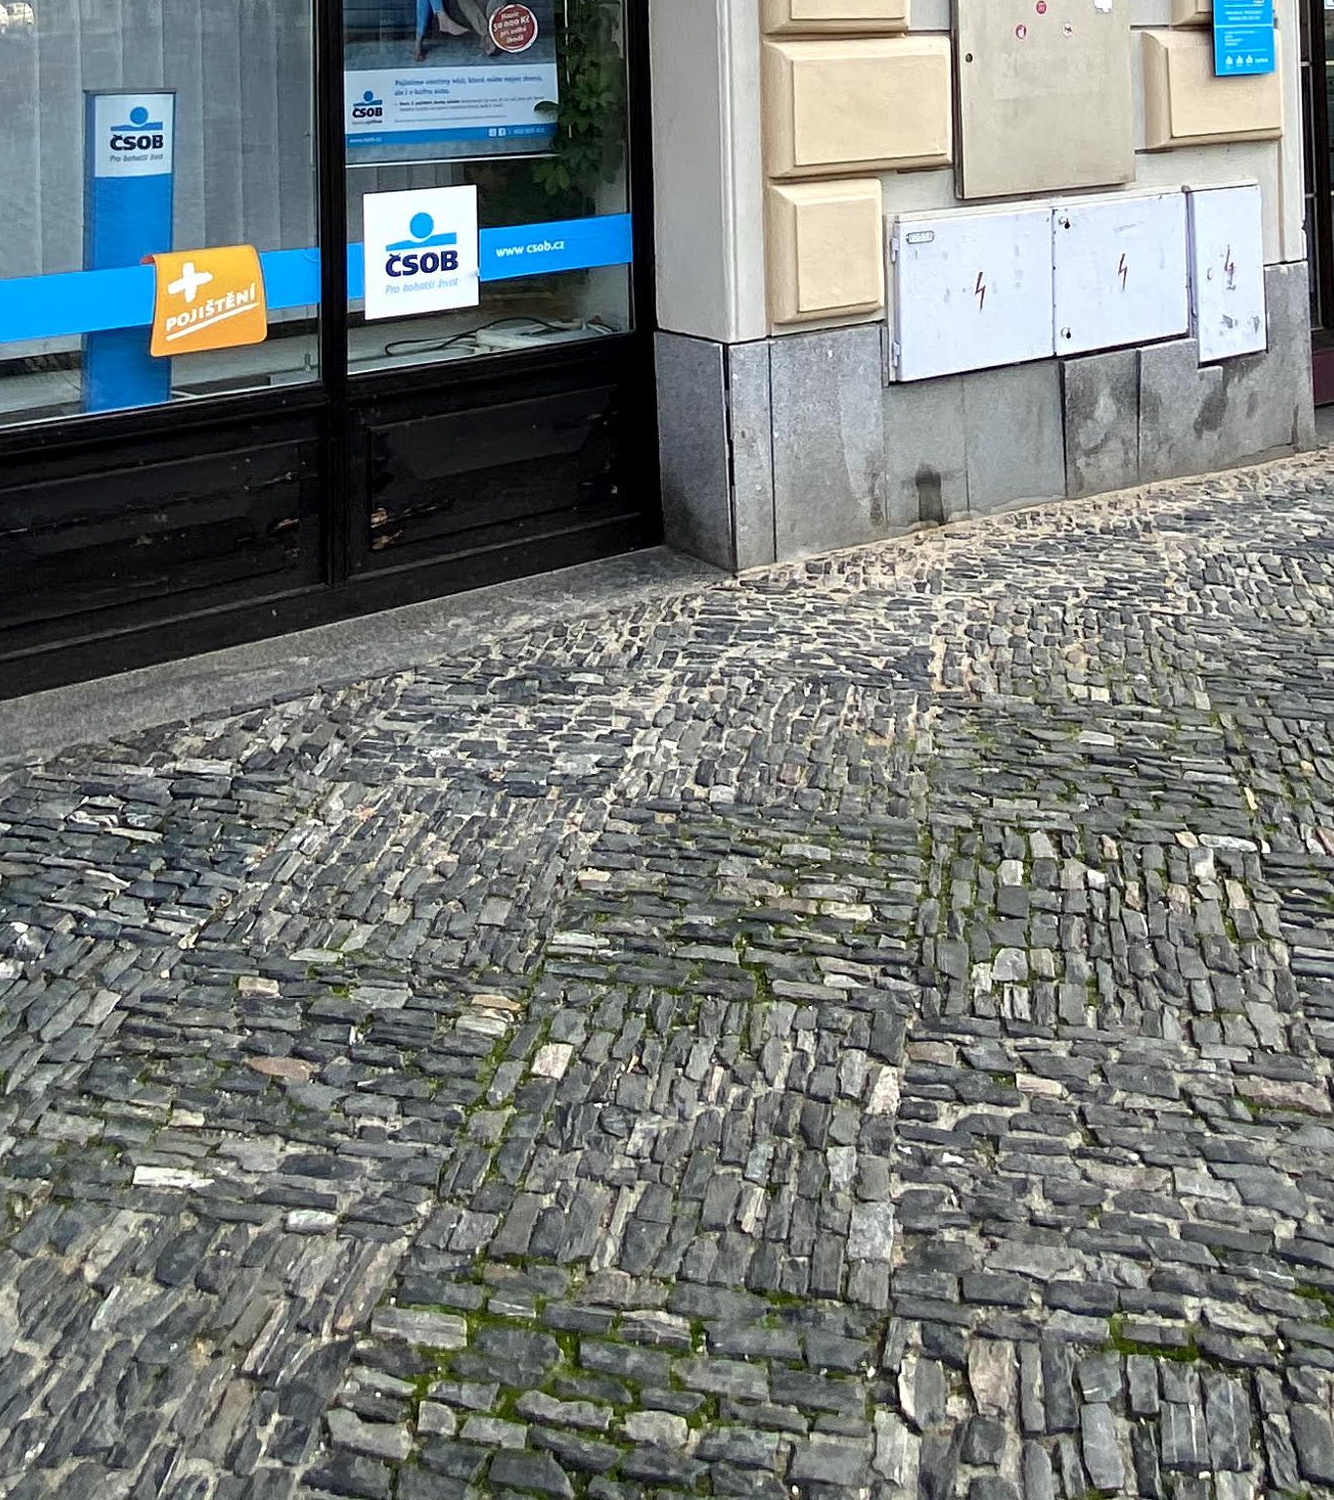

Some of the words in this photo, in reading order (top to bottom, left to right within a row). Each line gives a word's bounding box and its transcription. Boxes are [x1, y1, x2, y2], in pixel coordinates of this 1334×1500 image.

[110, 134, 164, 151] ČSOB
[495, 240, 565, 259] wwwcsob.cz
[385, 250, 459, 277] ČSOB
[385, 283, 400, 295] Pro
[165, 282, 257, 332] POJIŠTĚNÍ
